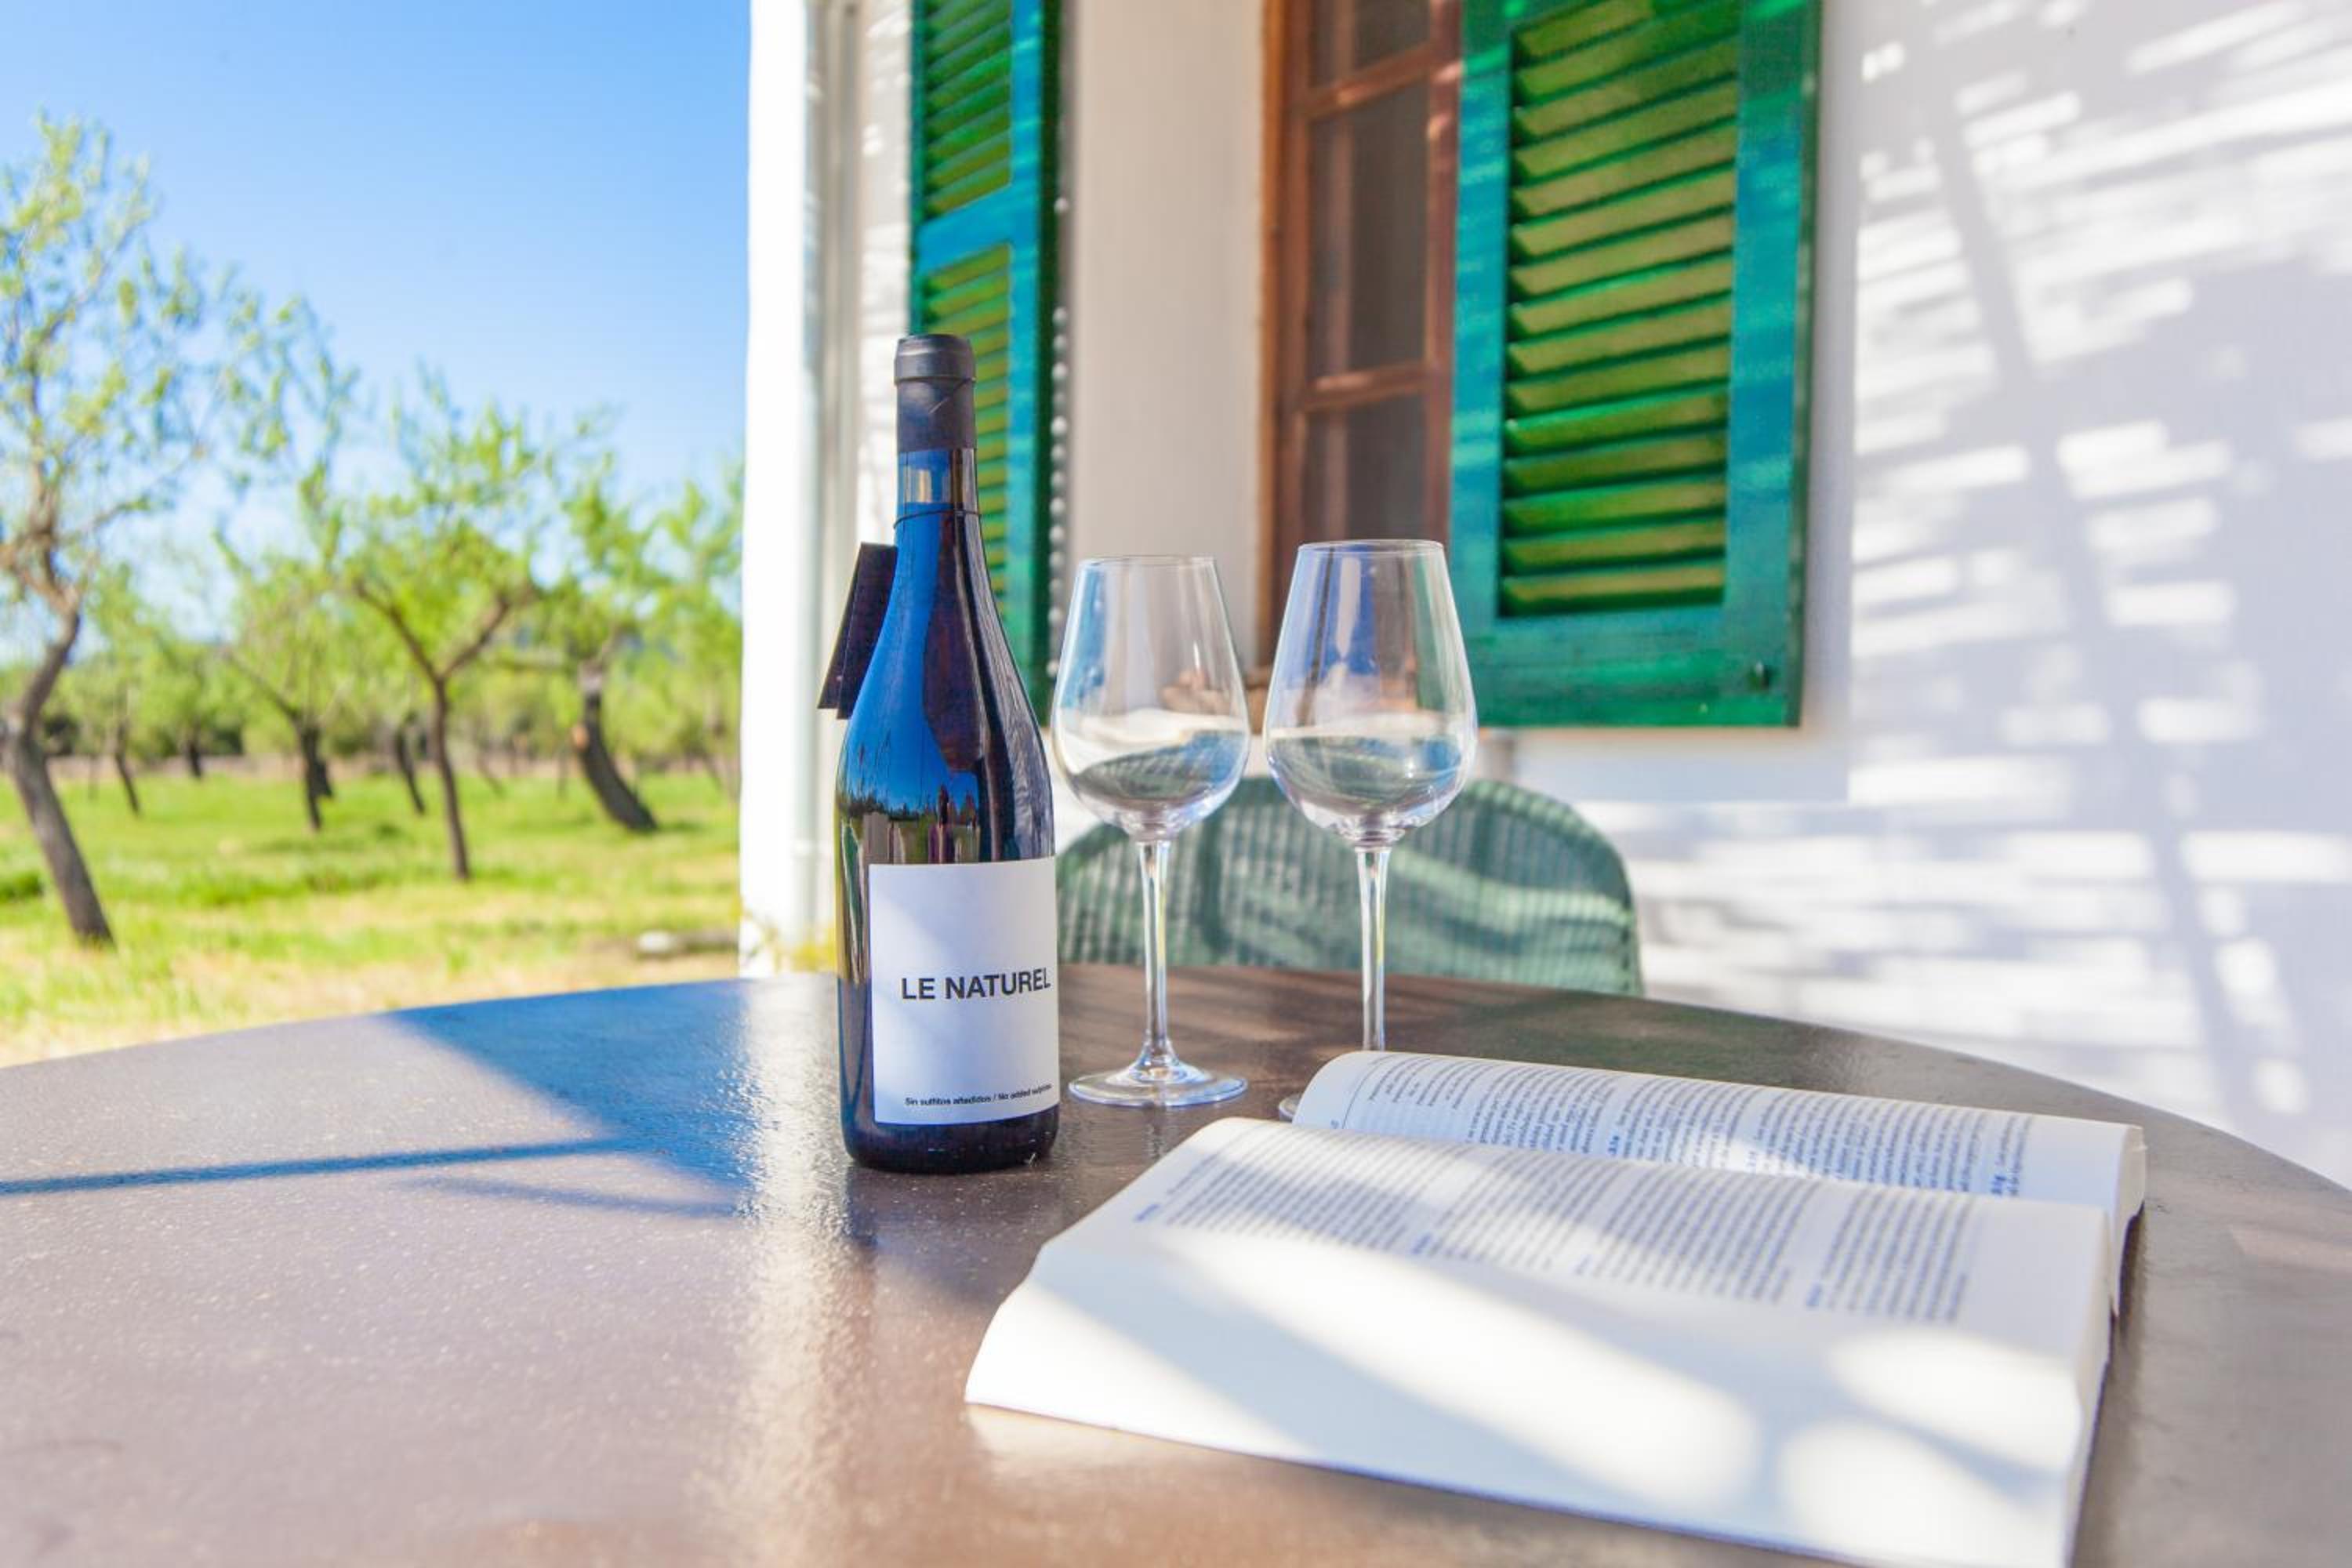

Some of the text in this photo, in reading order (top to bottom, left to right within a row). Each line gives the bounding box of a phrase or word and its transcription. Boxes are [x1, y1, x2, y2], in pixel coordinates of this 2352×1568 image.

[902, 967, 1051, 1000] LE NATUREL
[905, 1097, 918, 1105] Sin
